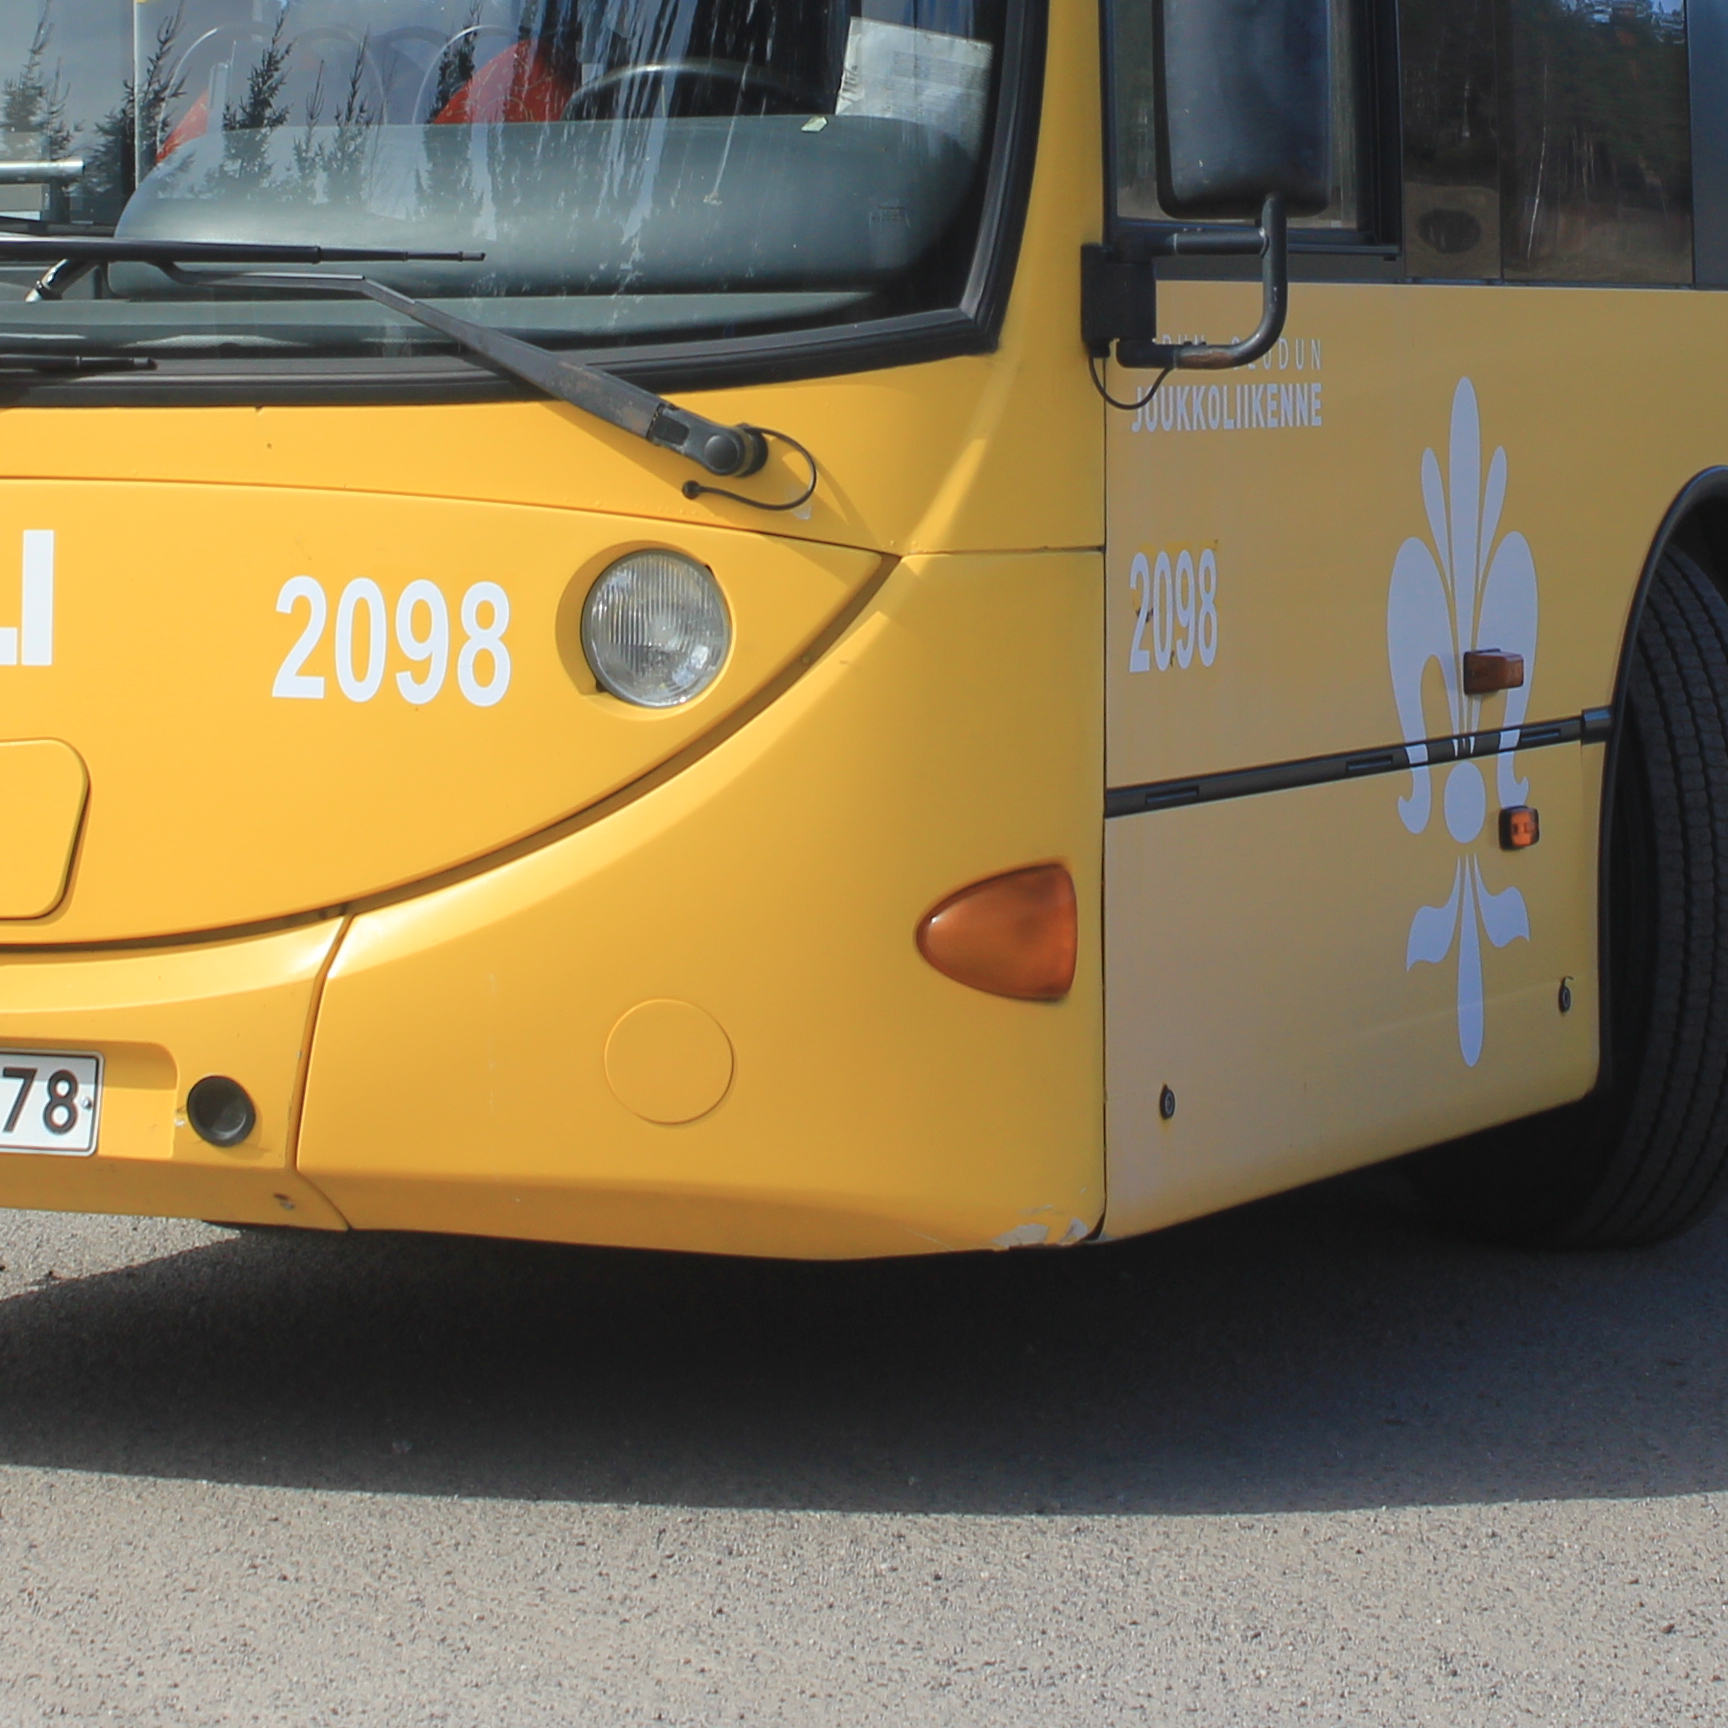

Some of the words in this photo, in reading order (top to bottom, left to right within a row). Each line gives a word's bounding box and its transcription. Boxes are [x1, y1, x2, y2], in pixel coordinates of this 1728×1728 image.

[1131, 382, 1322, 432] JOUKKOLIIKENNE
[272, 575, 511, 707] 2098
[1128, 548, 1218, 673] 2098
